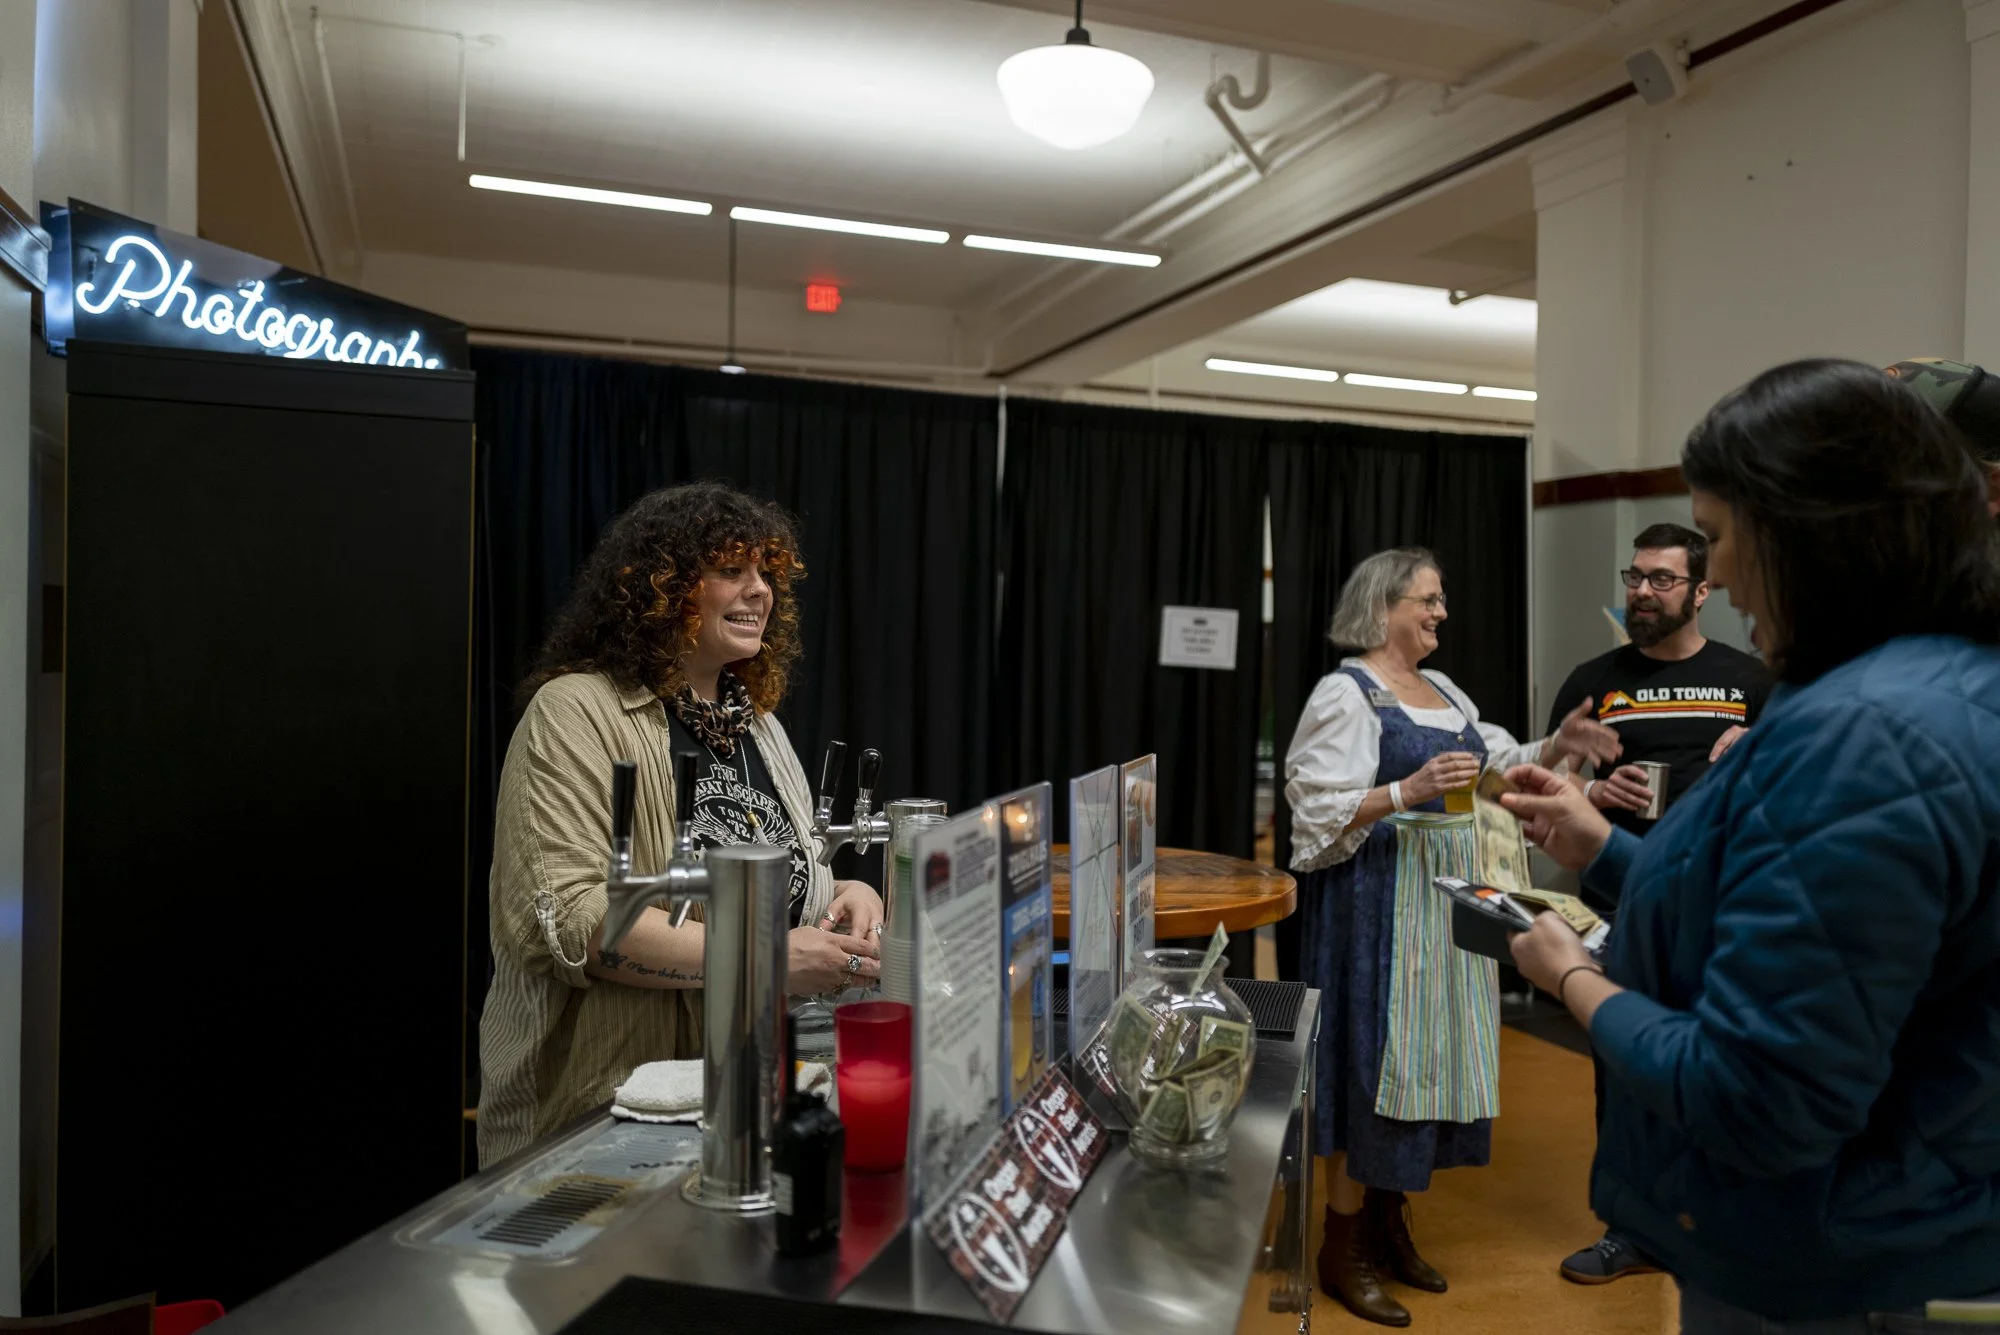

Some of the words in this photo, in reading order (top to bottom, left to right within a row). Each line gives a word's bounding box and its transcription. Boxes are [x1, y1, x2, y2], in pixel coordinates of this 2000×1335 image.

[1636, 688, 1670, 702] OLD
[1673, 687, 1725, 701] TOWN
[1716, 711, 1746, 722] BREWING
